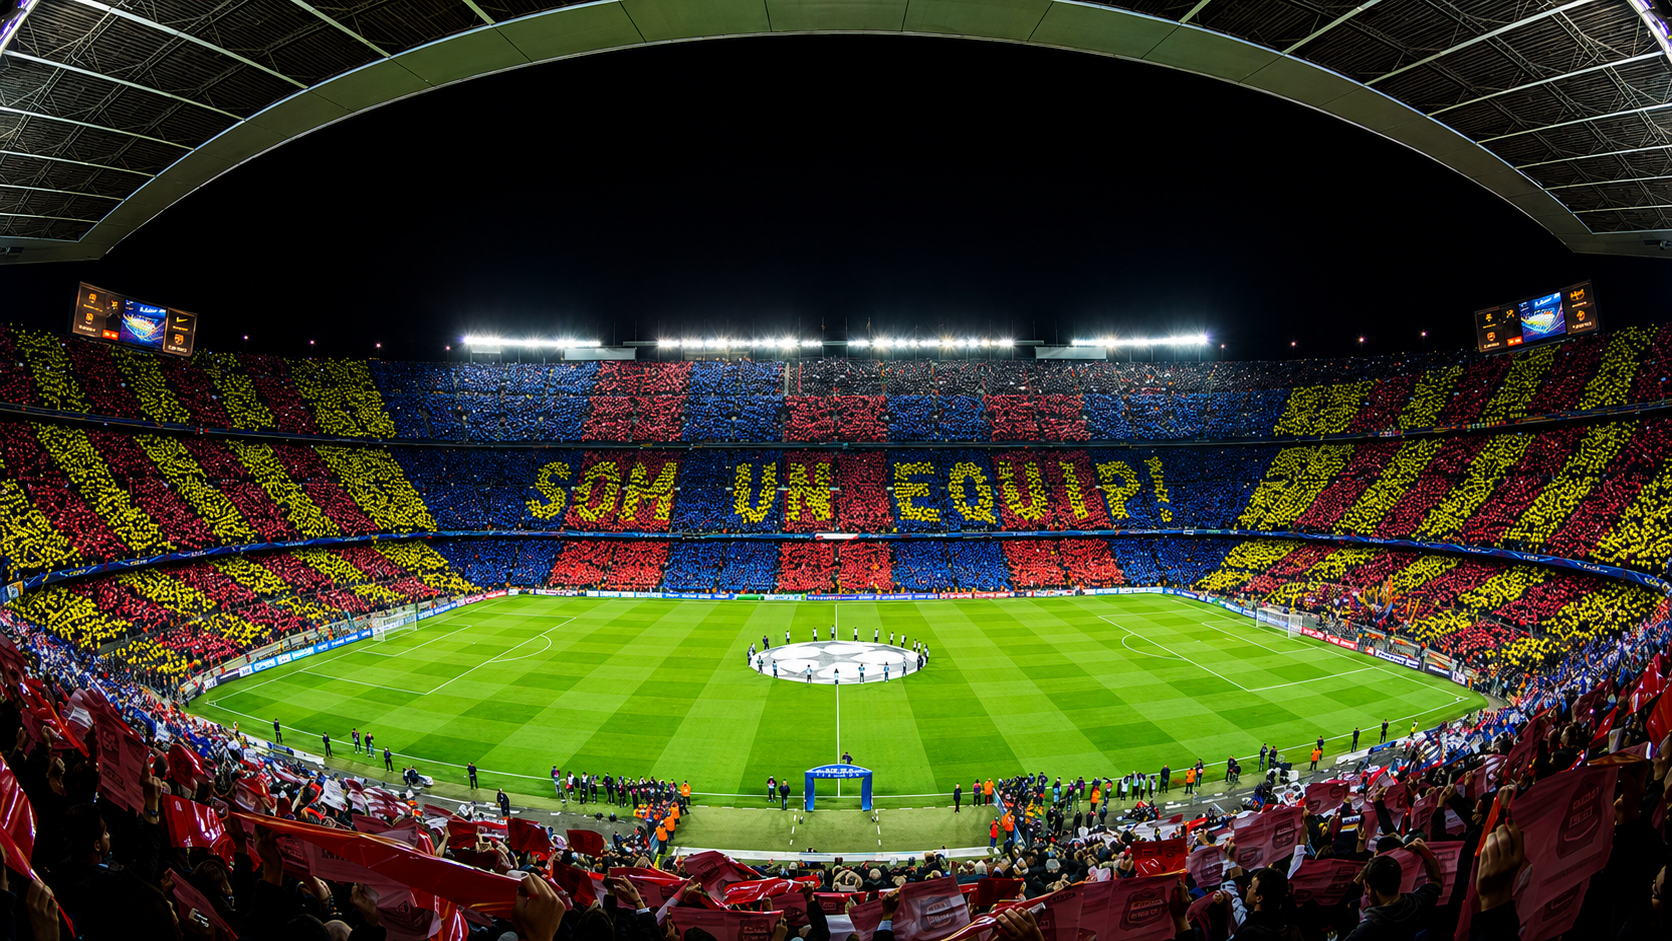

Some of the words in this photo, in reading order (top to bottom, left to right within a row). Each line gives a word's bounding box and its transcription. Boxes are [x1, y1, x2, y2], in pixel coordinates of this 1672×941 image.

[526, 461, 678, 522] SOM
[733, 461, 831, 523] UN
[893, 456, 1173, 524] EQUIP!
